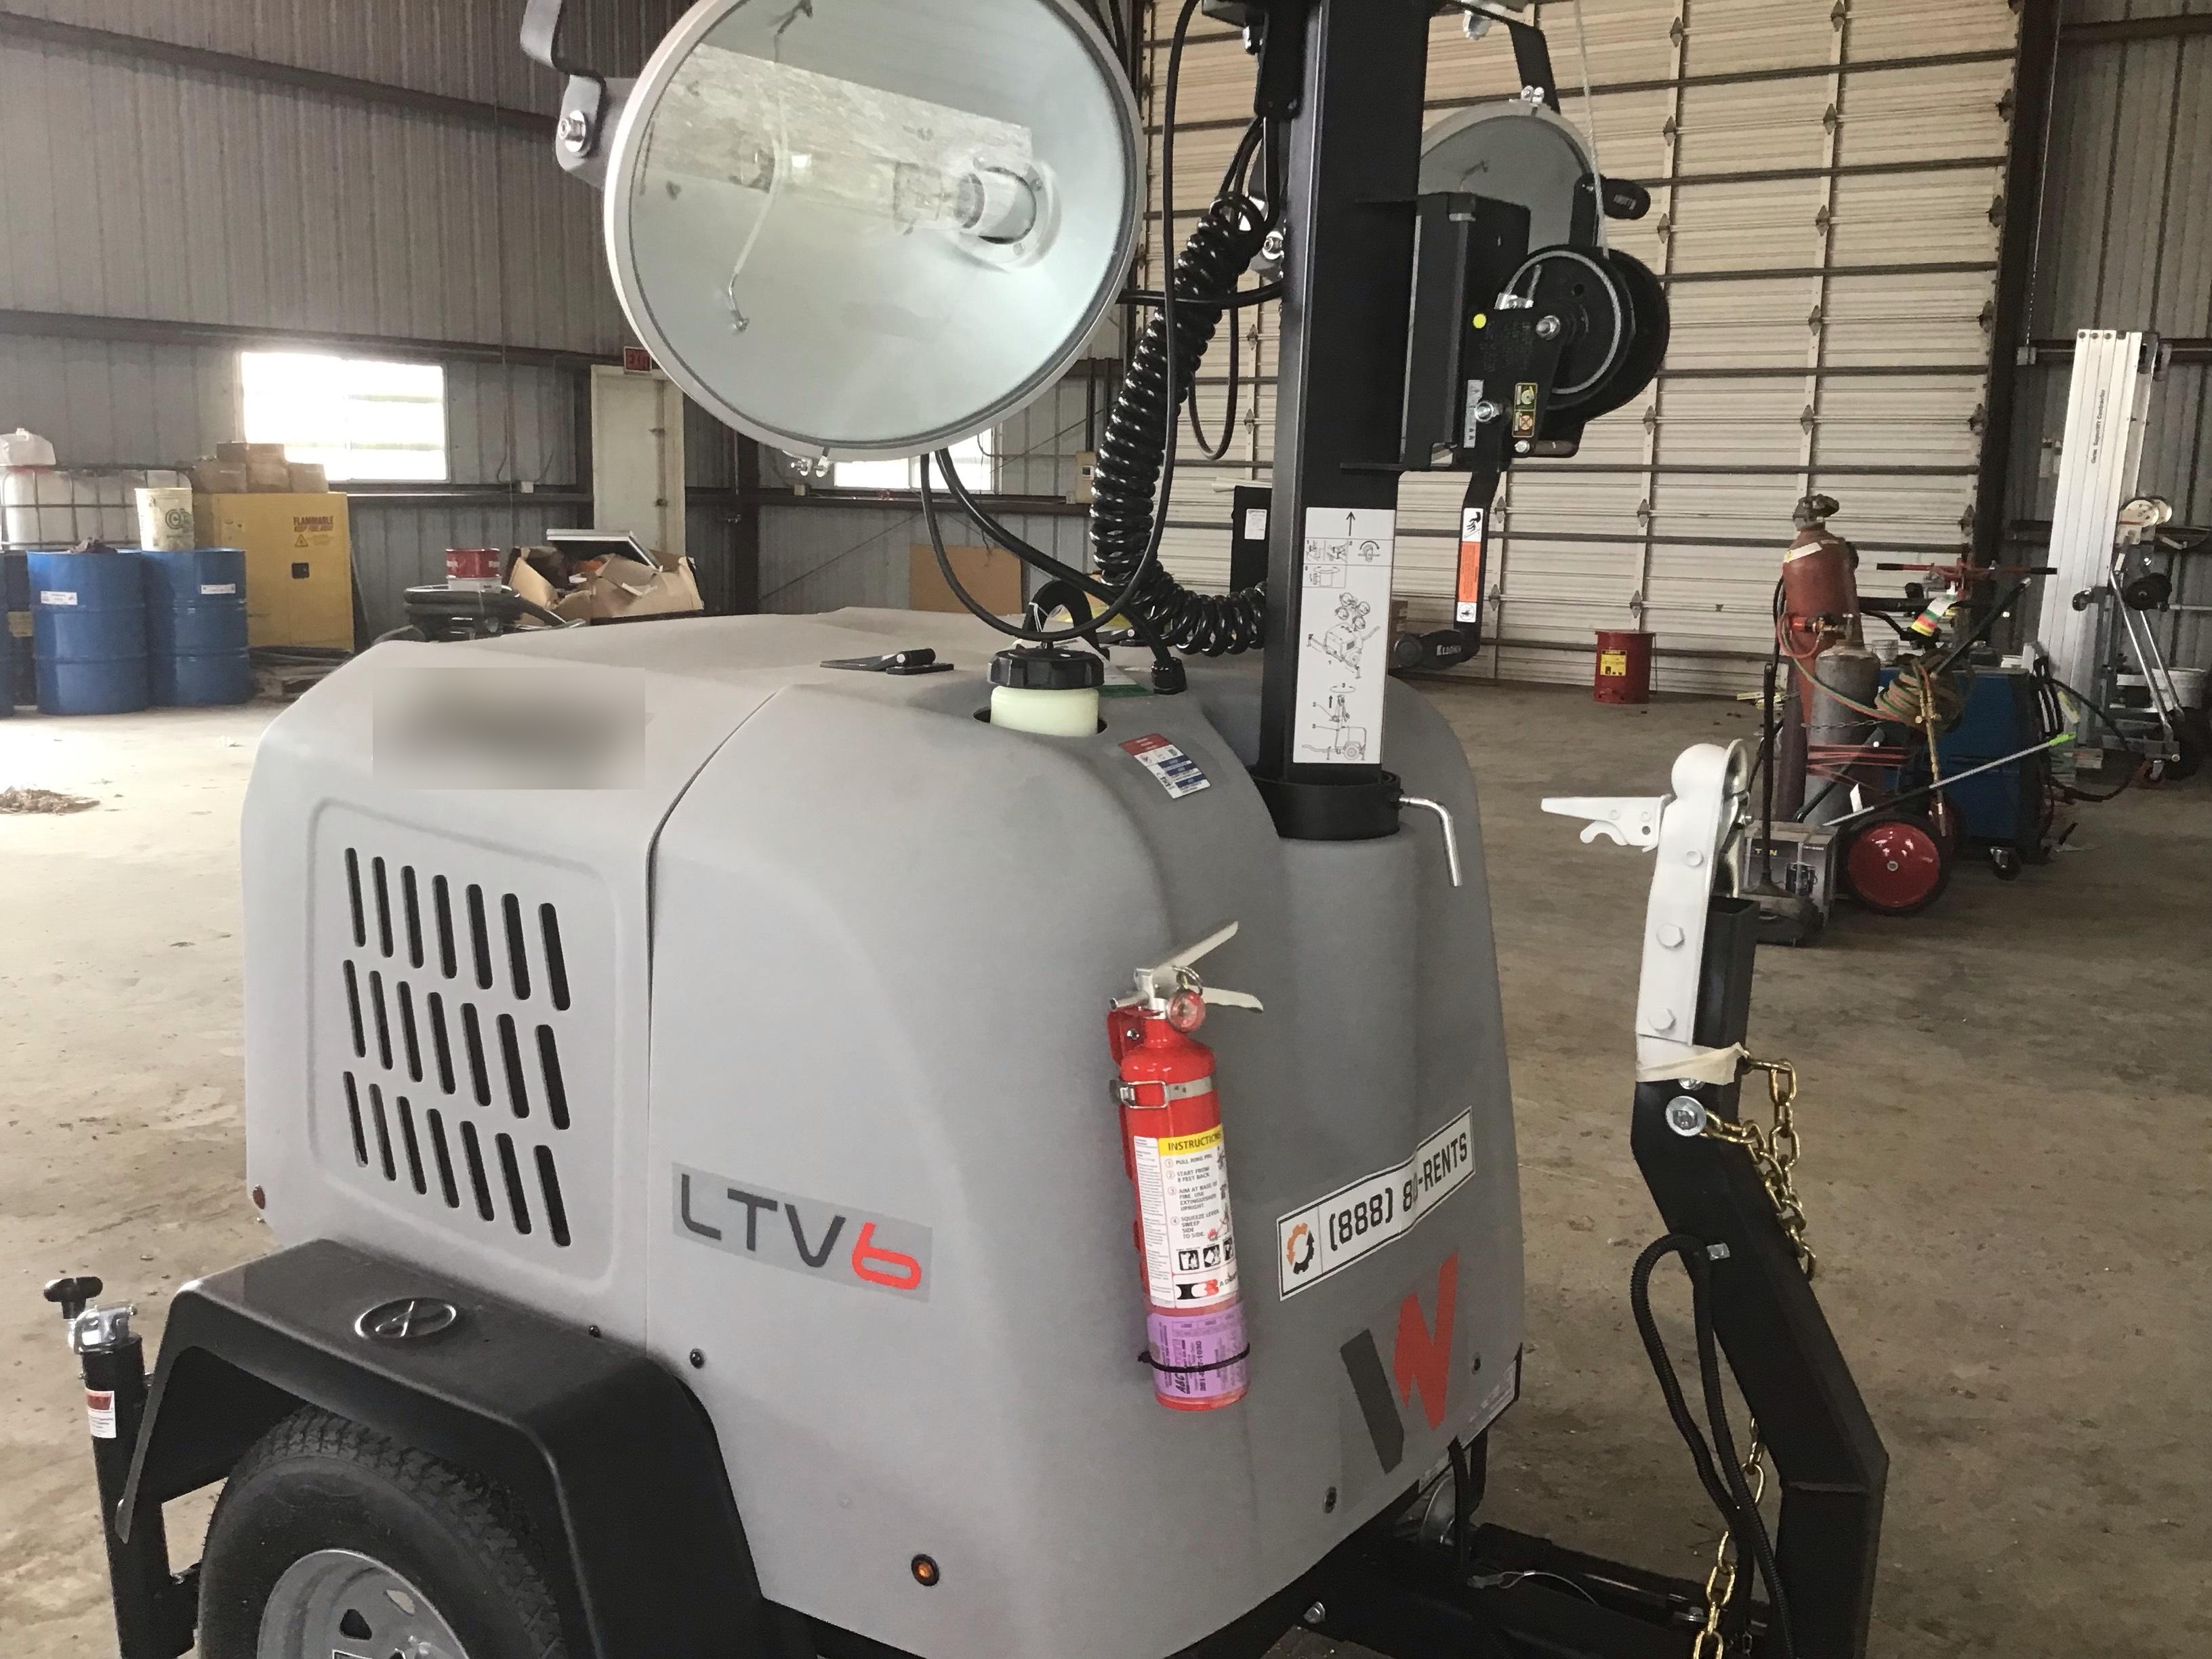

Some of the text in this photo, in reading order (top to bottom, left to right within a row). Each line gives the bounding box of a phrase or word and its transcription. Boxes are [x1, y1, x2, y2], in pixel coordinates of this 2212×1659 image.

[293, 516, 334, 526] FLAMMABLE
[680, 1173, 922, 1290] LTV6
[1181, 1212, 1204, 1221] SQUEEZE
[1330, 1187, 1393, 1251] (888)
